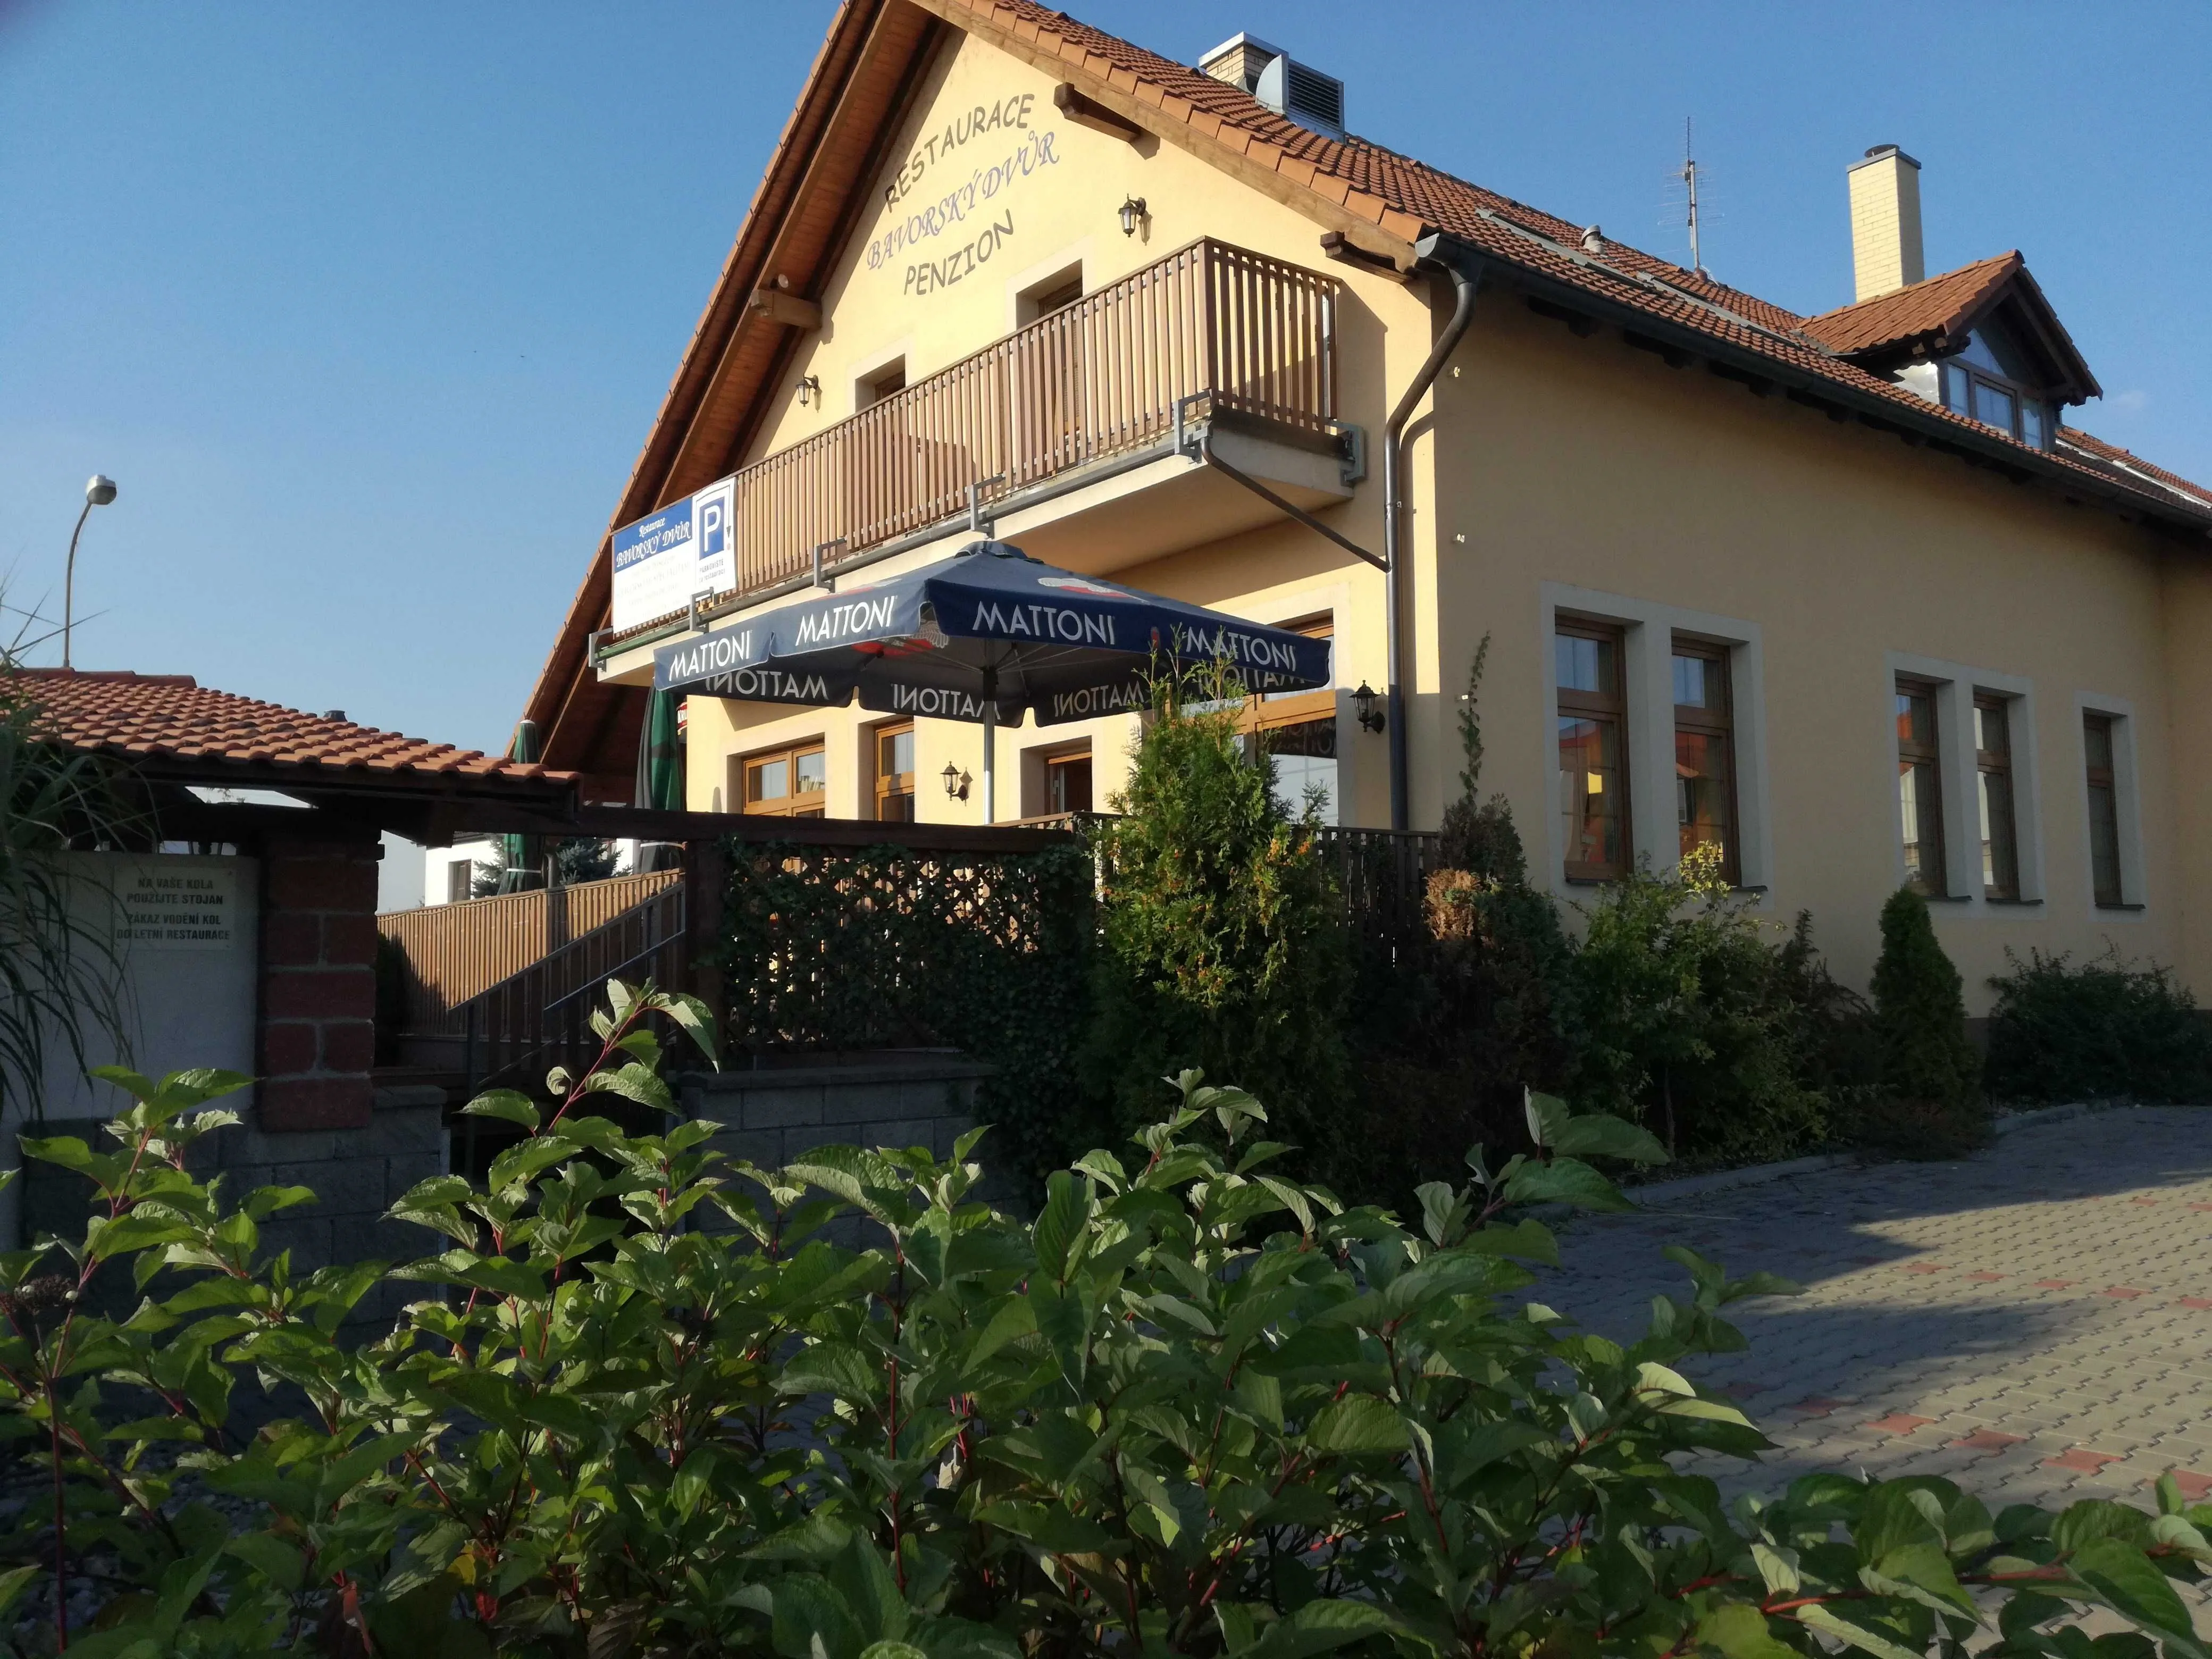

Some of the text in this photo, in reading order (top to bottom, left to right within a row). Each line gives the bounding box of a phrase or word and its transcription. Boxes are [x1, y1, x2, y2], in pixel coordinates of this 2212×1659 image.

[885, 94, 1034, 213] RESTAURACE
[867, 130, 1060, 270] BAVORSKÝ DVŮR
[903, 208, 1014, 295] PENZION
[617, 532, 660, 567] BAVORSKÝ
[639, 517, 666, 537] Restaurace
[704, 505, 720, 552] P
[795, 595, 894, 646] MATTONI
[973, 601, 1115, 645] MATTONI
[669, 630, 750, 681] MATTONI
[1187, 626, 1296, 672] MATTONI
[138, 876, 214, 889] NA VAŠE KOLA
[181, 895, 223, 904] STOJAN
[128, 911, 160, 924] ZÁKAZ
[203, 915, 221, 924] KOL
[135, 927, 163, 939] LETNÍ
[166, 931, 230, 940] RESTAURACE
